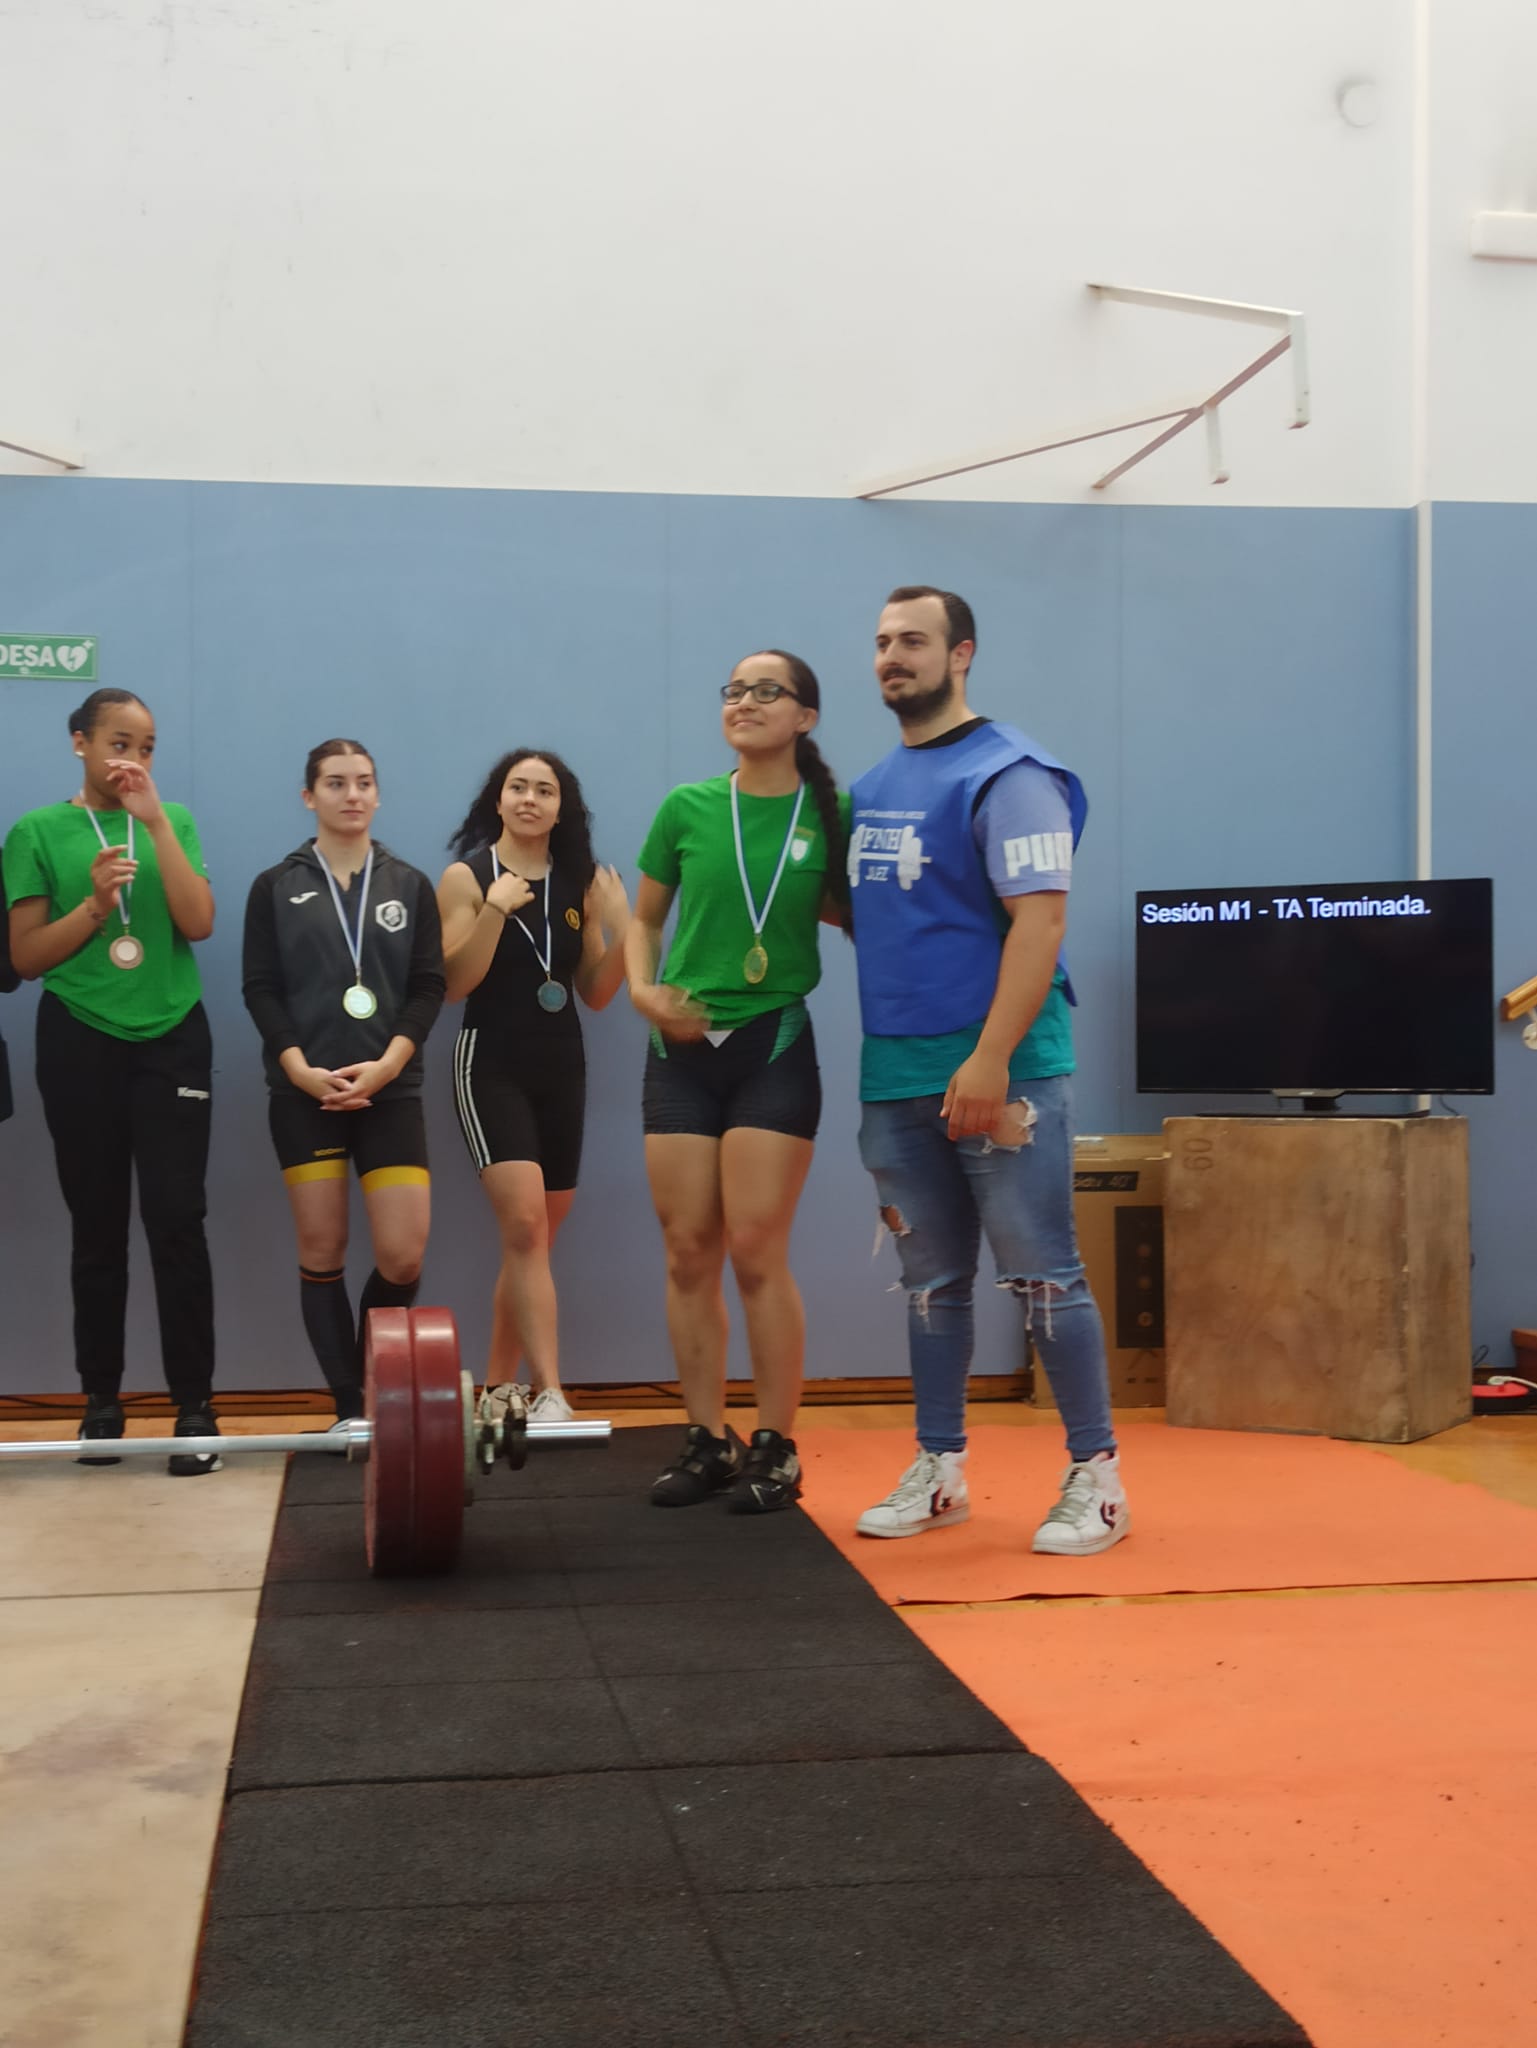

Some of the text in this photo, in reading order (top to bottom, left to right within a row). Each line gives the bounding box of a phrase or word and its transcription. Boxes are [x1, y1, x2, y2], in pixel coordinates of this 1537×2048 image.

[1003, 831, 1073, 878] PUM
[1142, 902, 1214, 924] Sesión
[1219, 900, 1251, 921] M1
[1272, 898, 1304, 919] TA
[1306, 894, 1432, 919] Terminada.
